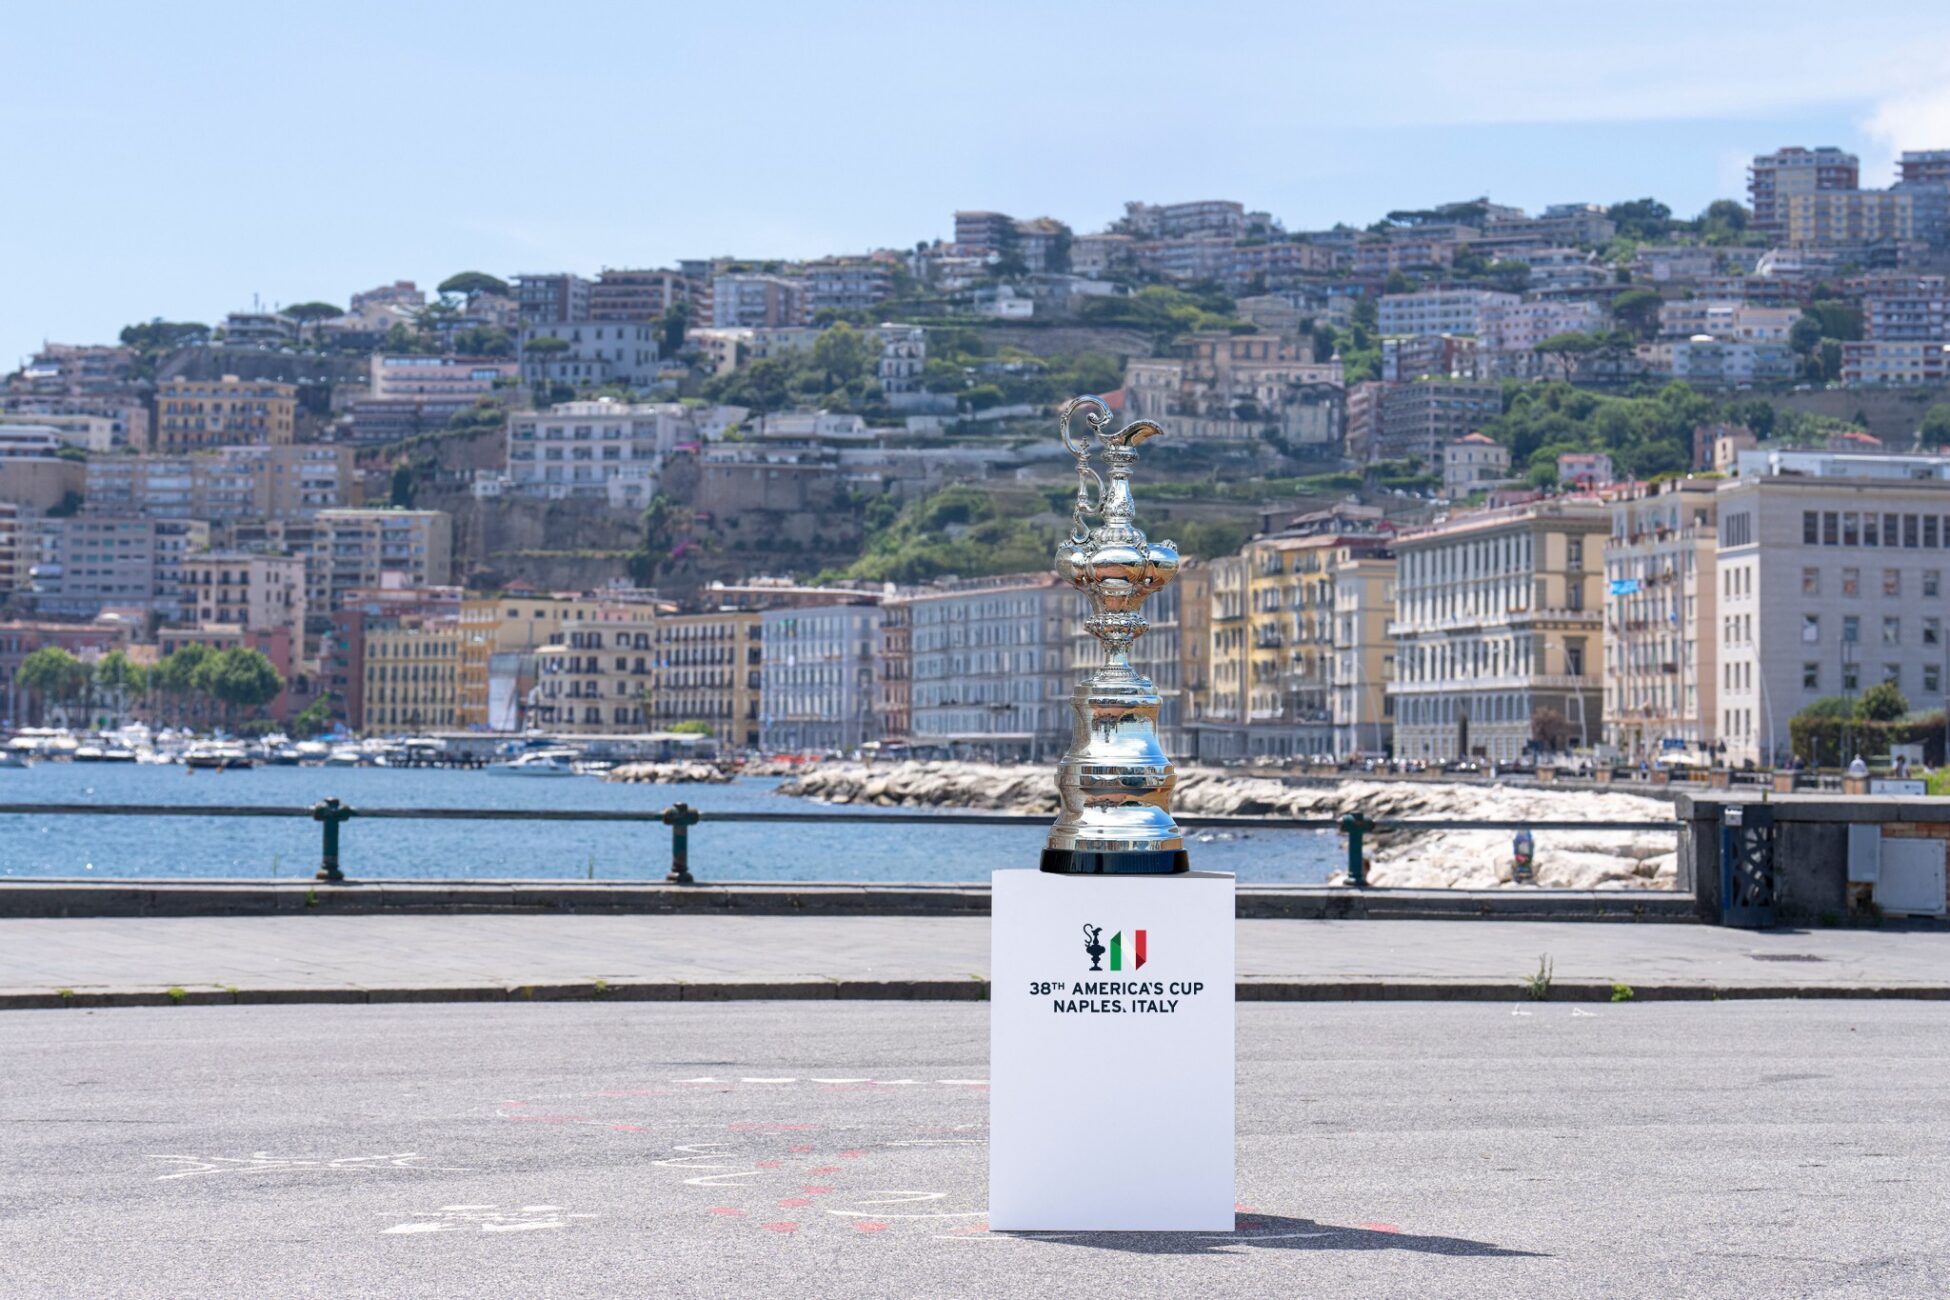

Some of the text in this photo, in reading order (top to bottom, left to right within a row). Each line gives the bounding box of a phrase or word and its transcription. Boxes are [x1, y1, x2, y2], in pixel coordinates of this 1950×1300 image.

[1029, 981, 1204, 996] 38TH AMERICA'S CUP
[1132, 999, 1179, 1014] ITALY
